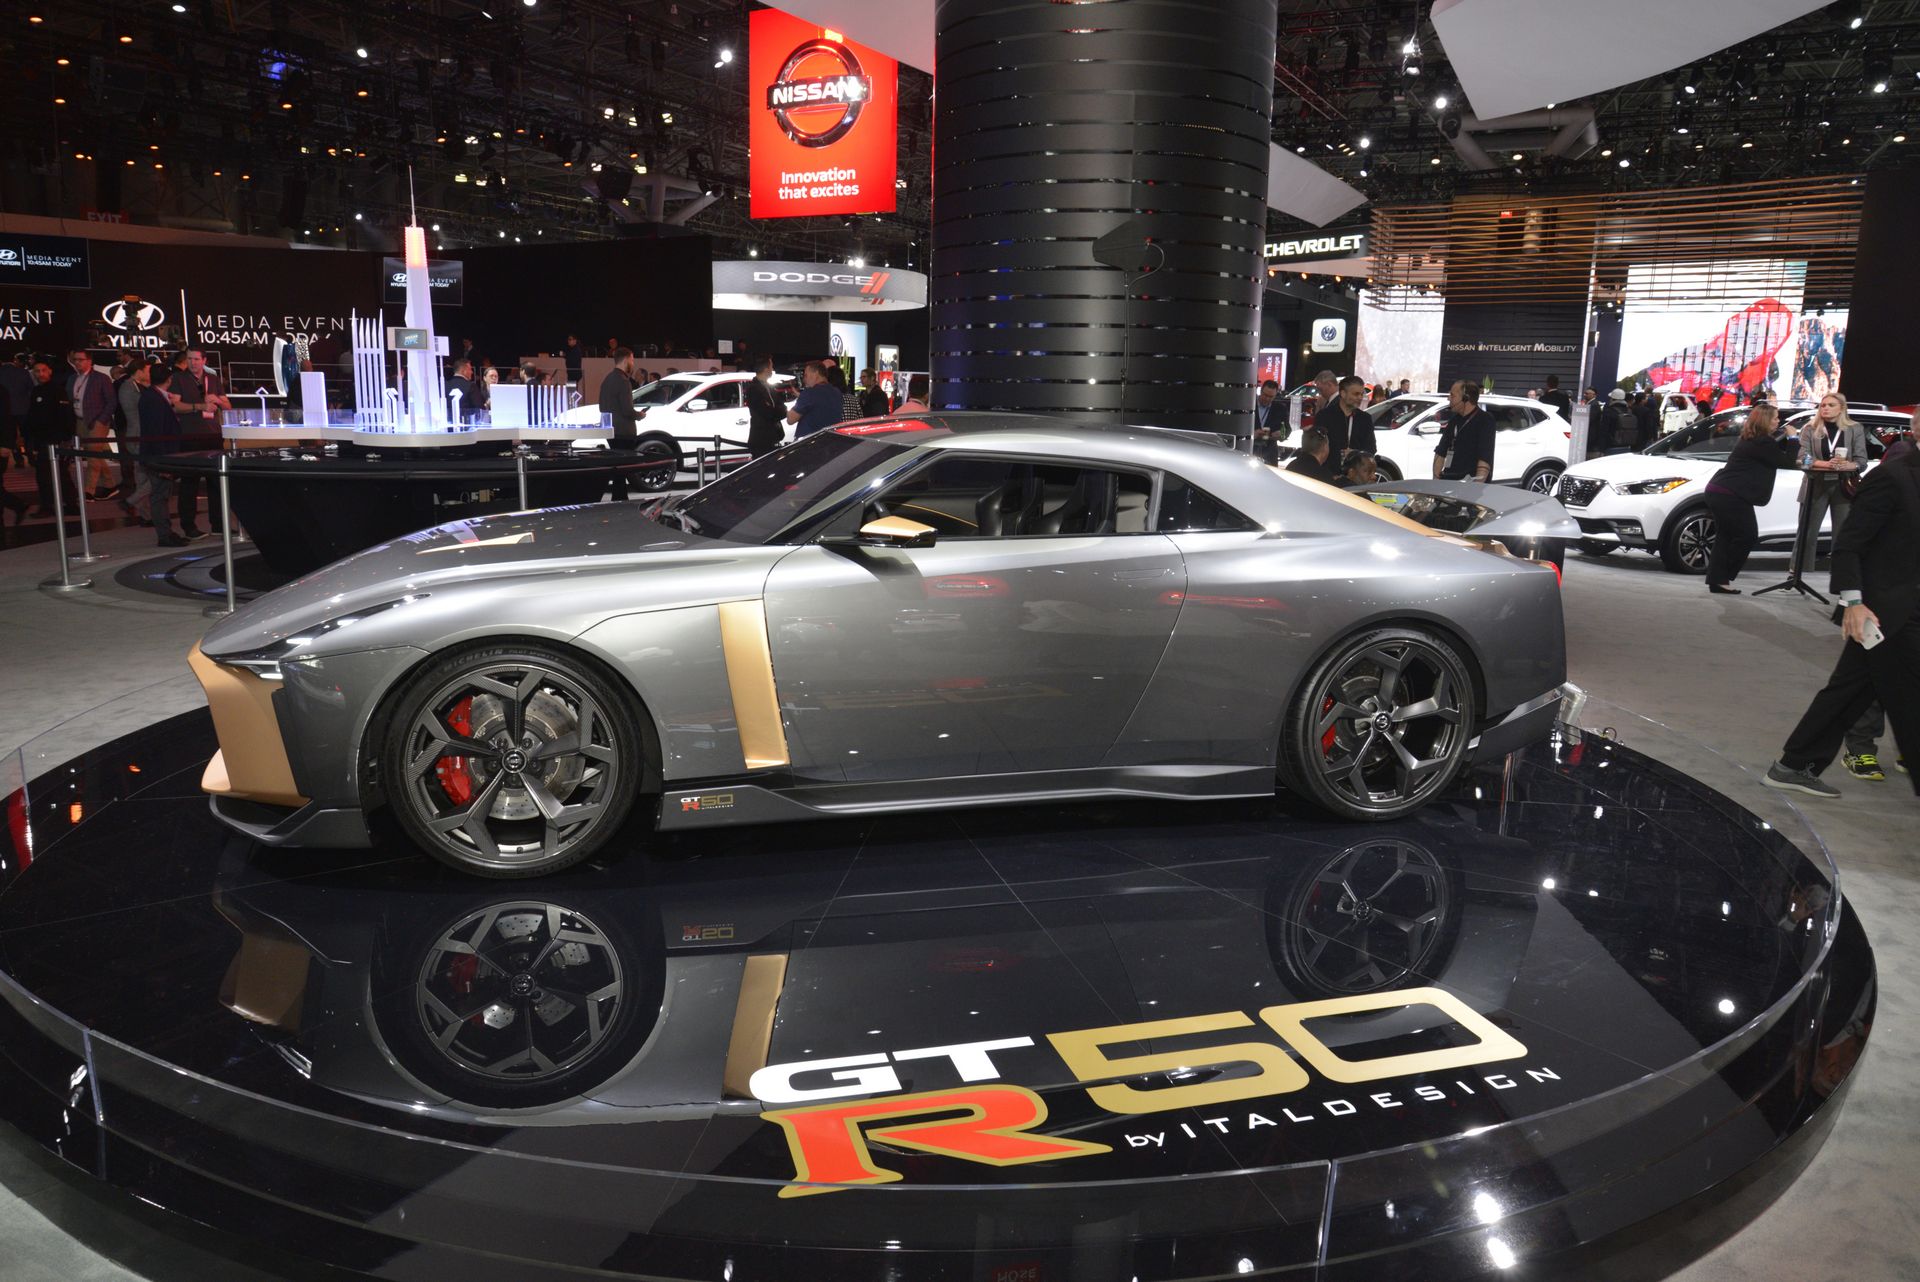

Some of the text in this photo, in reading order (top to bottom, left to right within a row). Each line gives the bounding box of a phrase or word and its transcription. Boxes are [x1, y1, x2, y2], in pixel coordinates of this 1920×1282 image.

[772, 80, 864, 105] NISSAN
[781, 167, 856, 184] Innovation
[778, 182, 860, 200] that excites
[1263, 234, 1364, 257] CHEVROLET
[753, 271, 874, 286] DODGE
[197, 314, 271, 329] MEDIA
[1478, 341, 1532, 352] INTELLIGENT
[1534, 342, 1577, 352] MOBILITY
[1265, 355, 1273, 373] Track
[1045, 986, 1529, 1115] 50
[749, 1036, 1036, 1104] GT
[1125, 1066, 1561, 1148] by ITALDESIGN
[760, 1084, 1114, 1199] R
